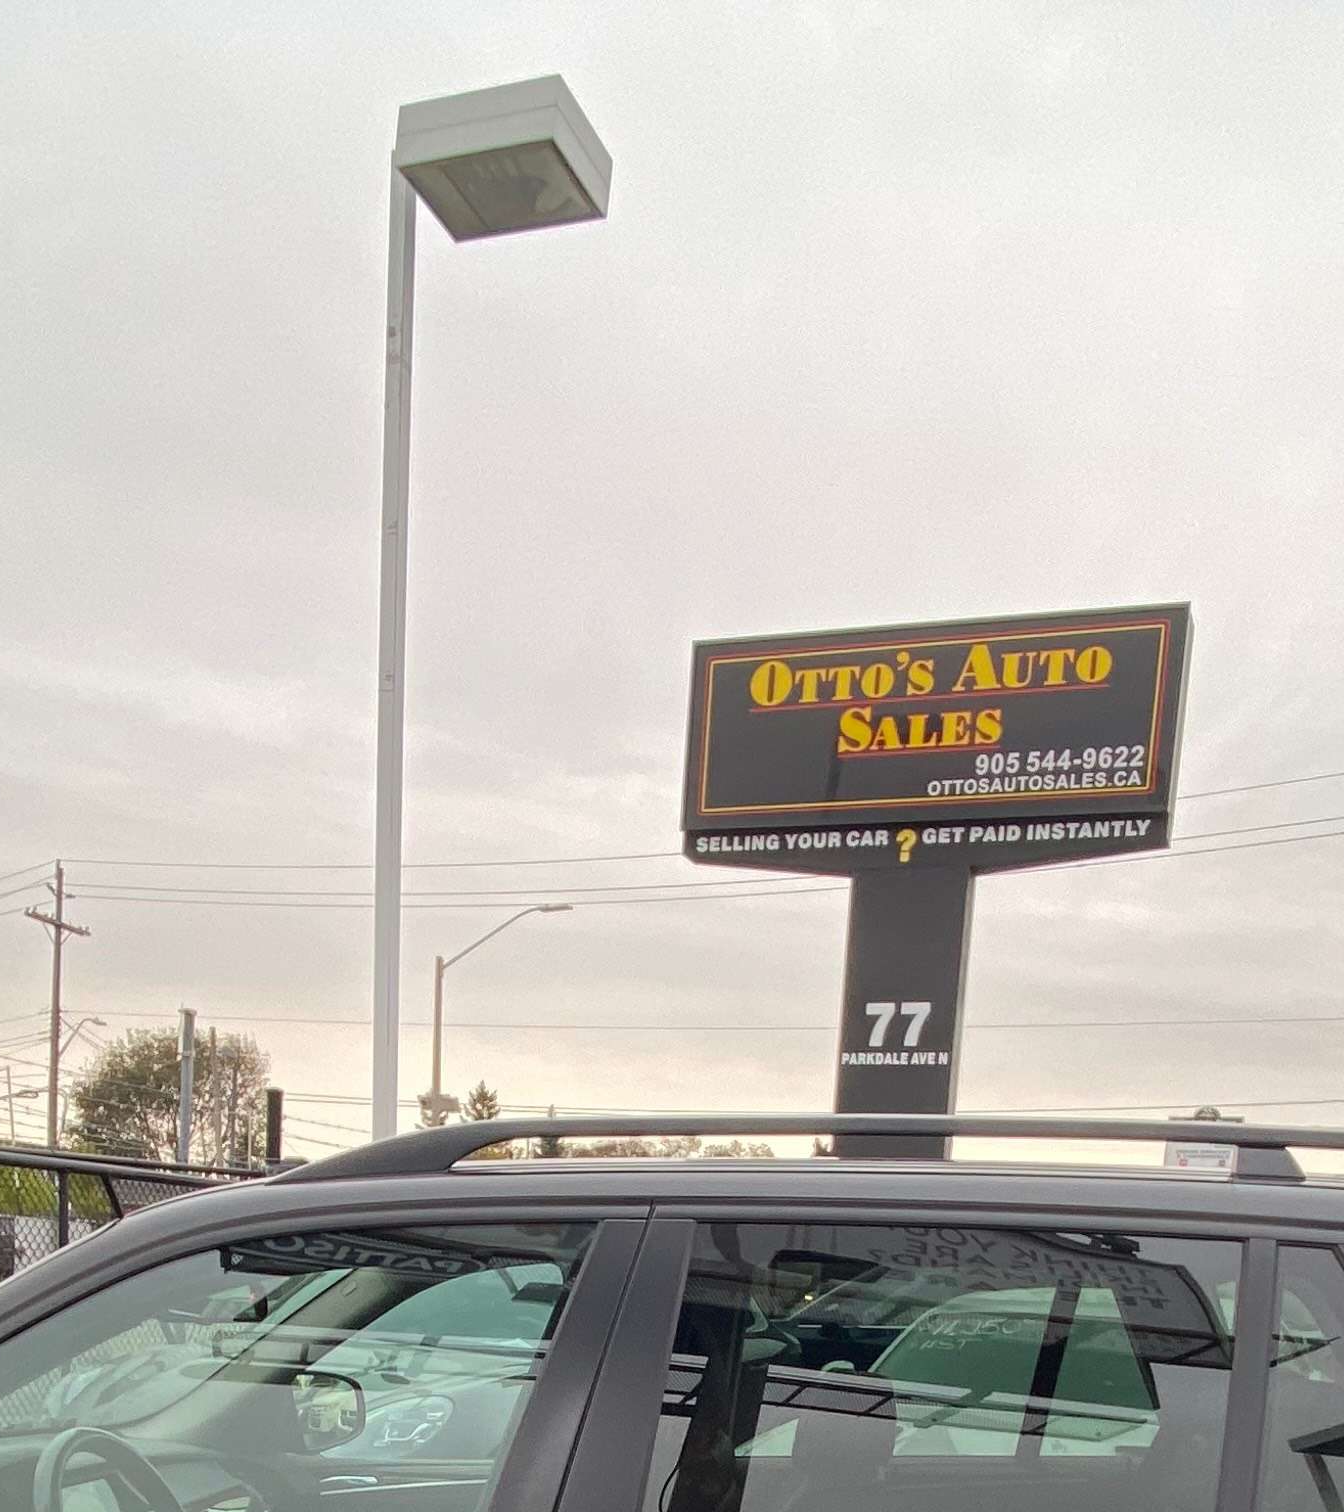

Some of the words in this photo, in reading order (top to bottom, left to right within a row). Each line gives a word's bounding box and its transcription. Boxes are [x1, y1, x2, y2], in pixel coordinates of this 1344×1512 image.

[750, 651, 934, 706] OTTO'S
[952, 641, 1113, 691] AUTO
[837, 705, 1003, 753] SALES
[975, 752, 1020, 776] 905
[1026, 745, 1145, 773] 544-9622
[927, 770, 1142, 796] OTTOSAUTOSALES.CA
[696, 834, 779, 852] SELLING
[784, 831, 841, 850] YOUR
[846, 829, 889, 848] CAR
[896, 828, 918, 863] ?
[922, 827, 965, 844] GET
[969, 824, 1021, 843] PAID
[1026, 819, 1152, 841] INSTANTLY
[865, 1002, 932, 1047] 77
[841, 1052, 909, 1065] PARKDALE
[911, 1052, 937, 1065] AVE
[938, 1052, 949, 1065] N
